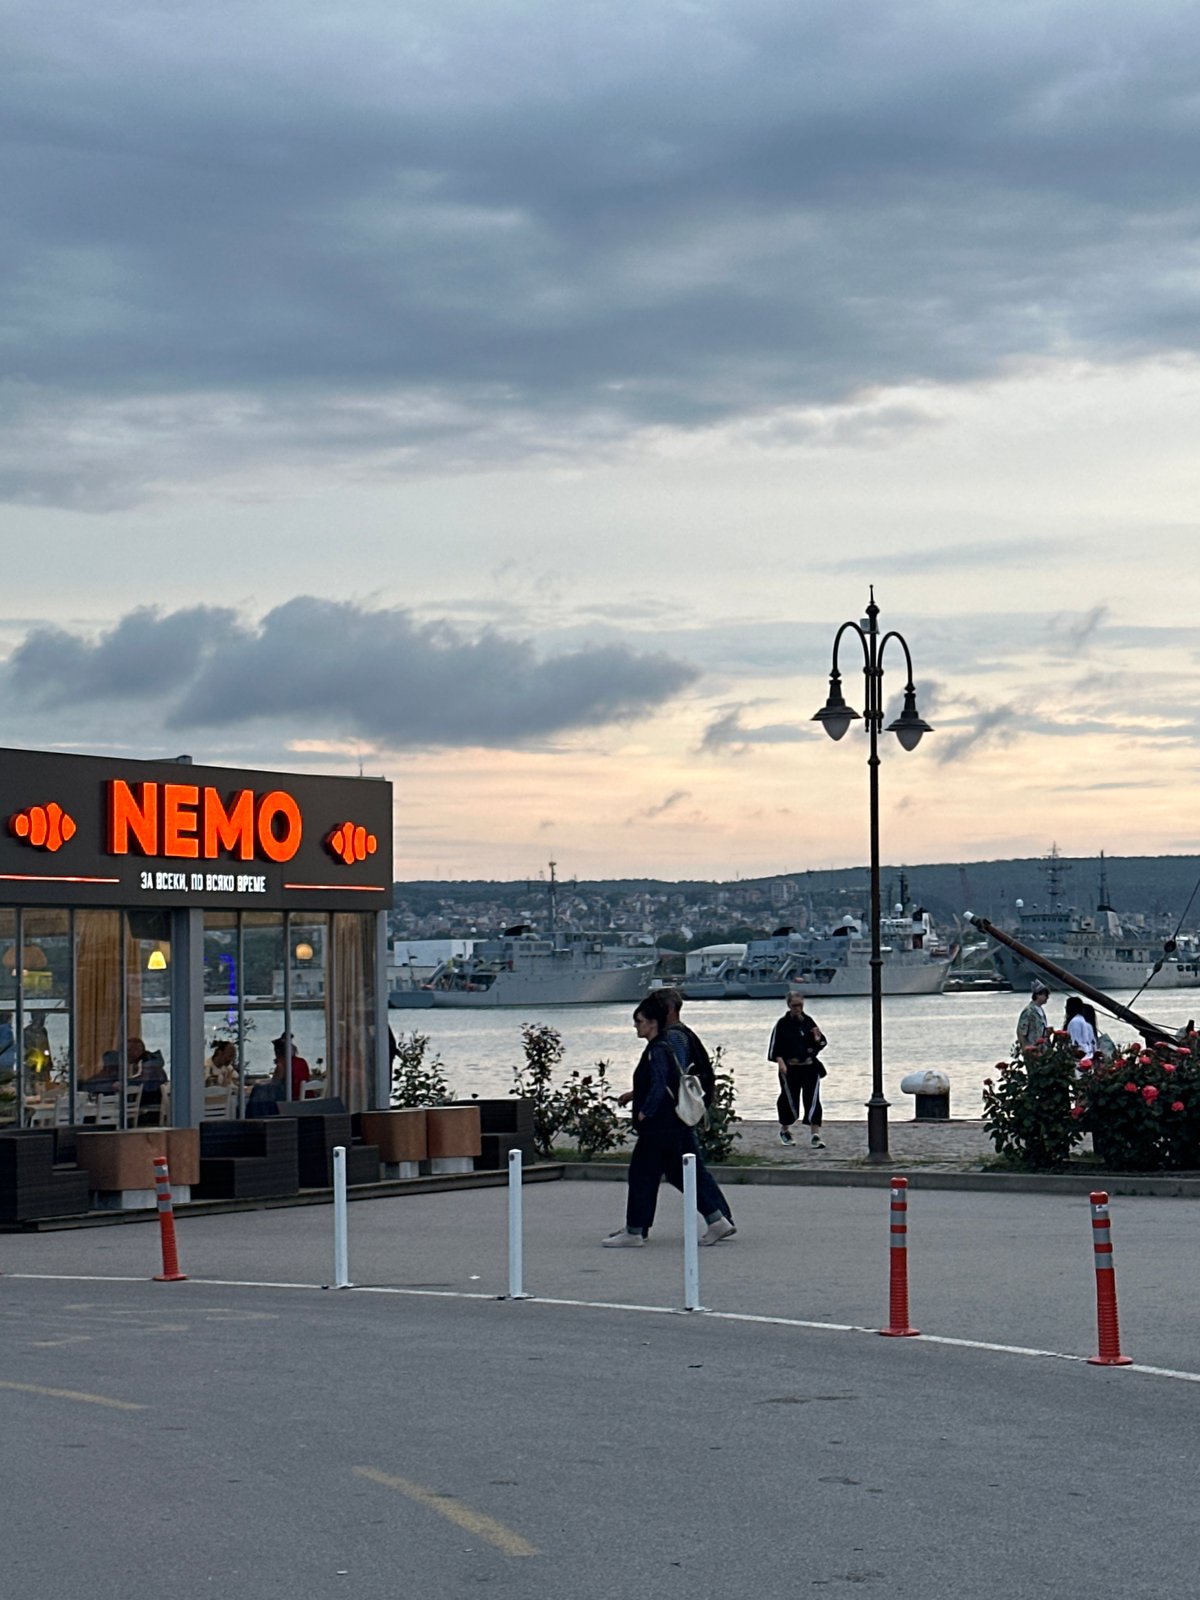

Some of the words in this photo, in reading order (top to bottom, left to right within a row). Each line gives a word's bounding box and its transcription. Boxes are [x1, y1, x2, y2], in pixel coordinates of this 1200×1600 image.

[109, 779, 302, 862] NEMO
[141, 871, 153, 889] ЗА
[156, 872, 188, 892] ВСЕКИ,
[191, 873, 203, 891] ПО
[206, 874, 234, 892] ВСЯКО
[237, 875, 266, 892] ВРЕМЕ
